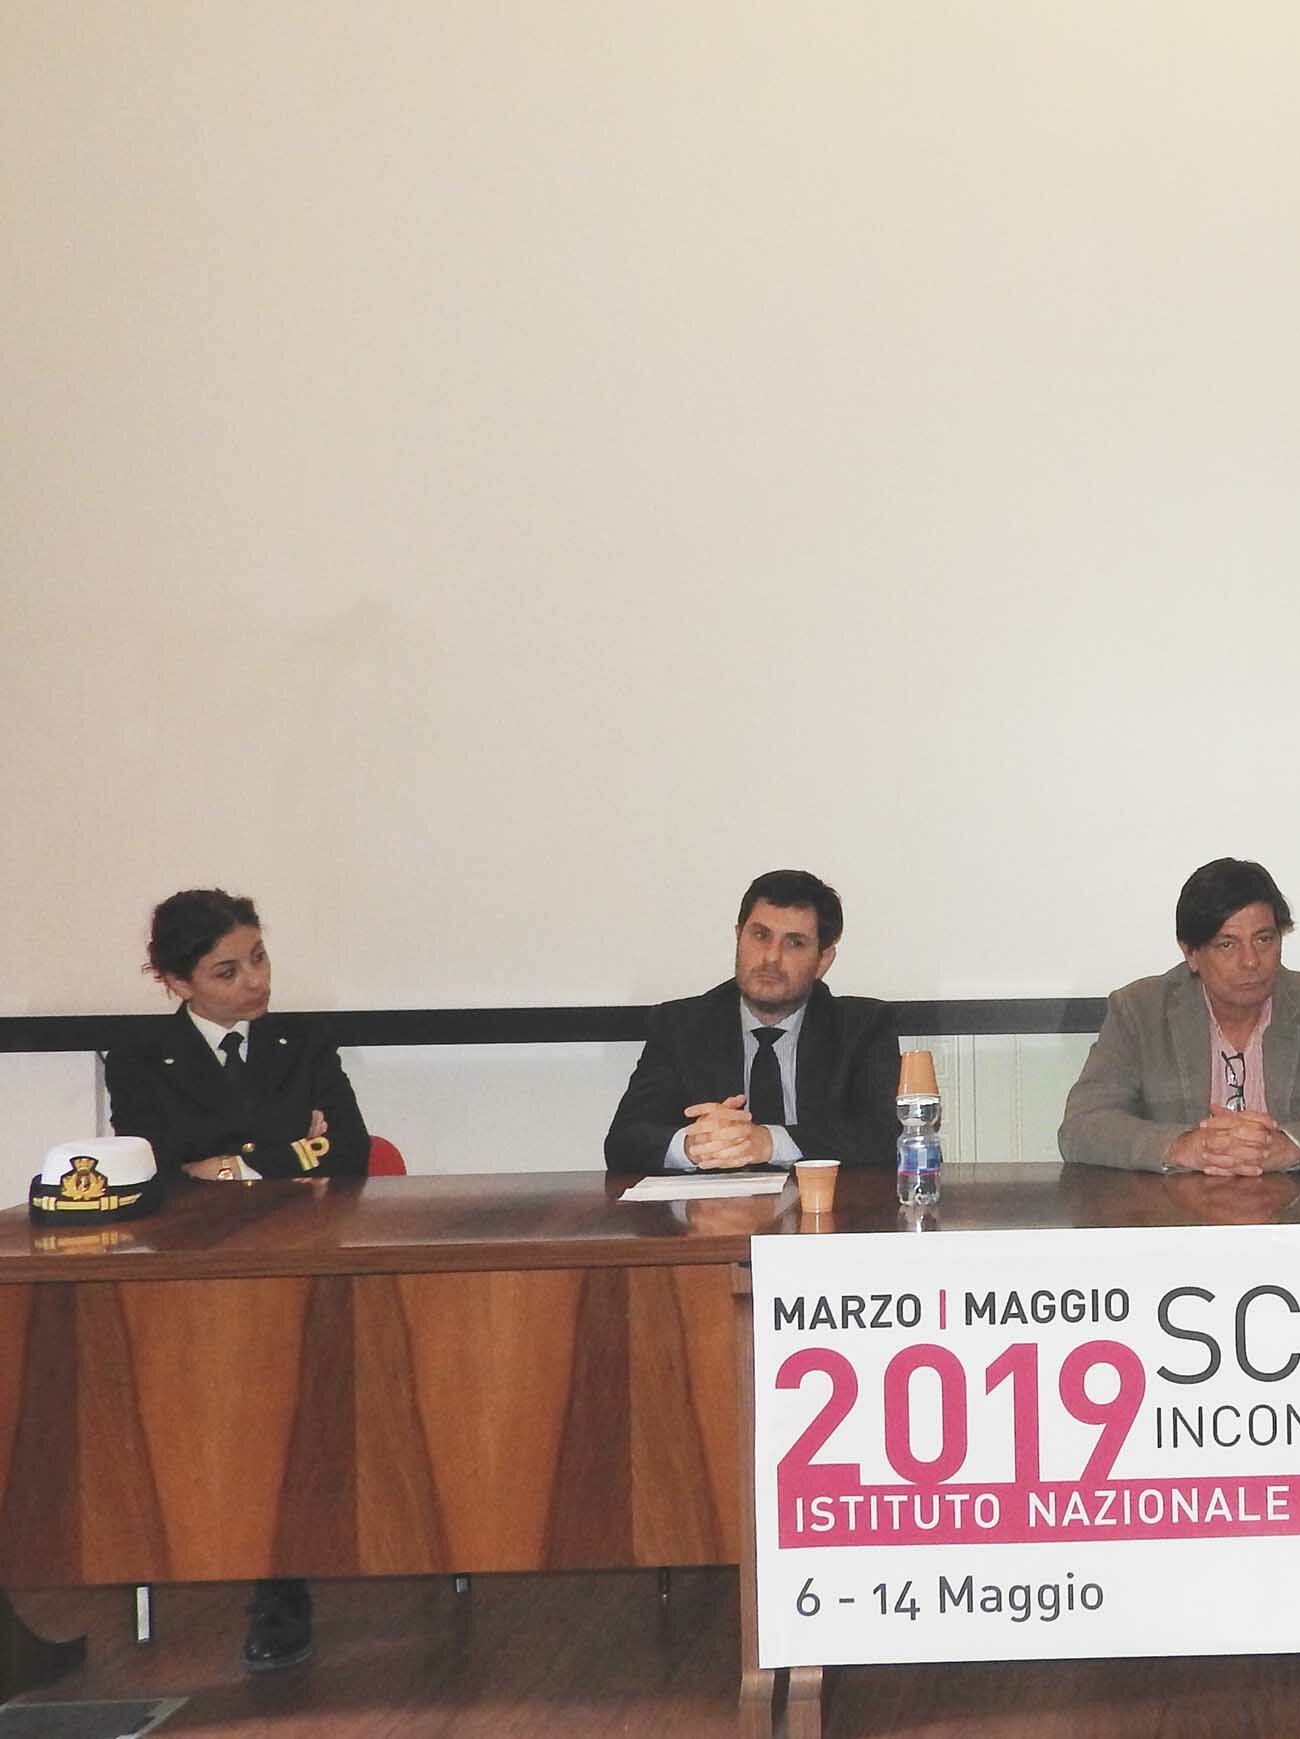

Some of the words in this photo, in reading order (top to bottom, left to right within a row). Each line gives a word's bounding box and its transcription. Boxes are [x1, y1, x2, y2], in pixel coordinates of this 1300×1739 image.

[774, 1293, 922, 1331] MARZO
[965, 1288, 1130, 1326] MAGGIO
[775, 1340, 1146, 1485] 2019
[796, 1493, 1000, 1533] ISTITUTO
[1028, 1485, 1290, 1528] NAZIONALE
[796, 1577, 821, 1617] 6
[872, 1580, 921, 1621] 14
[939, 1572, 1104, 1623] Maggio
